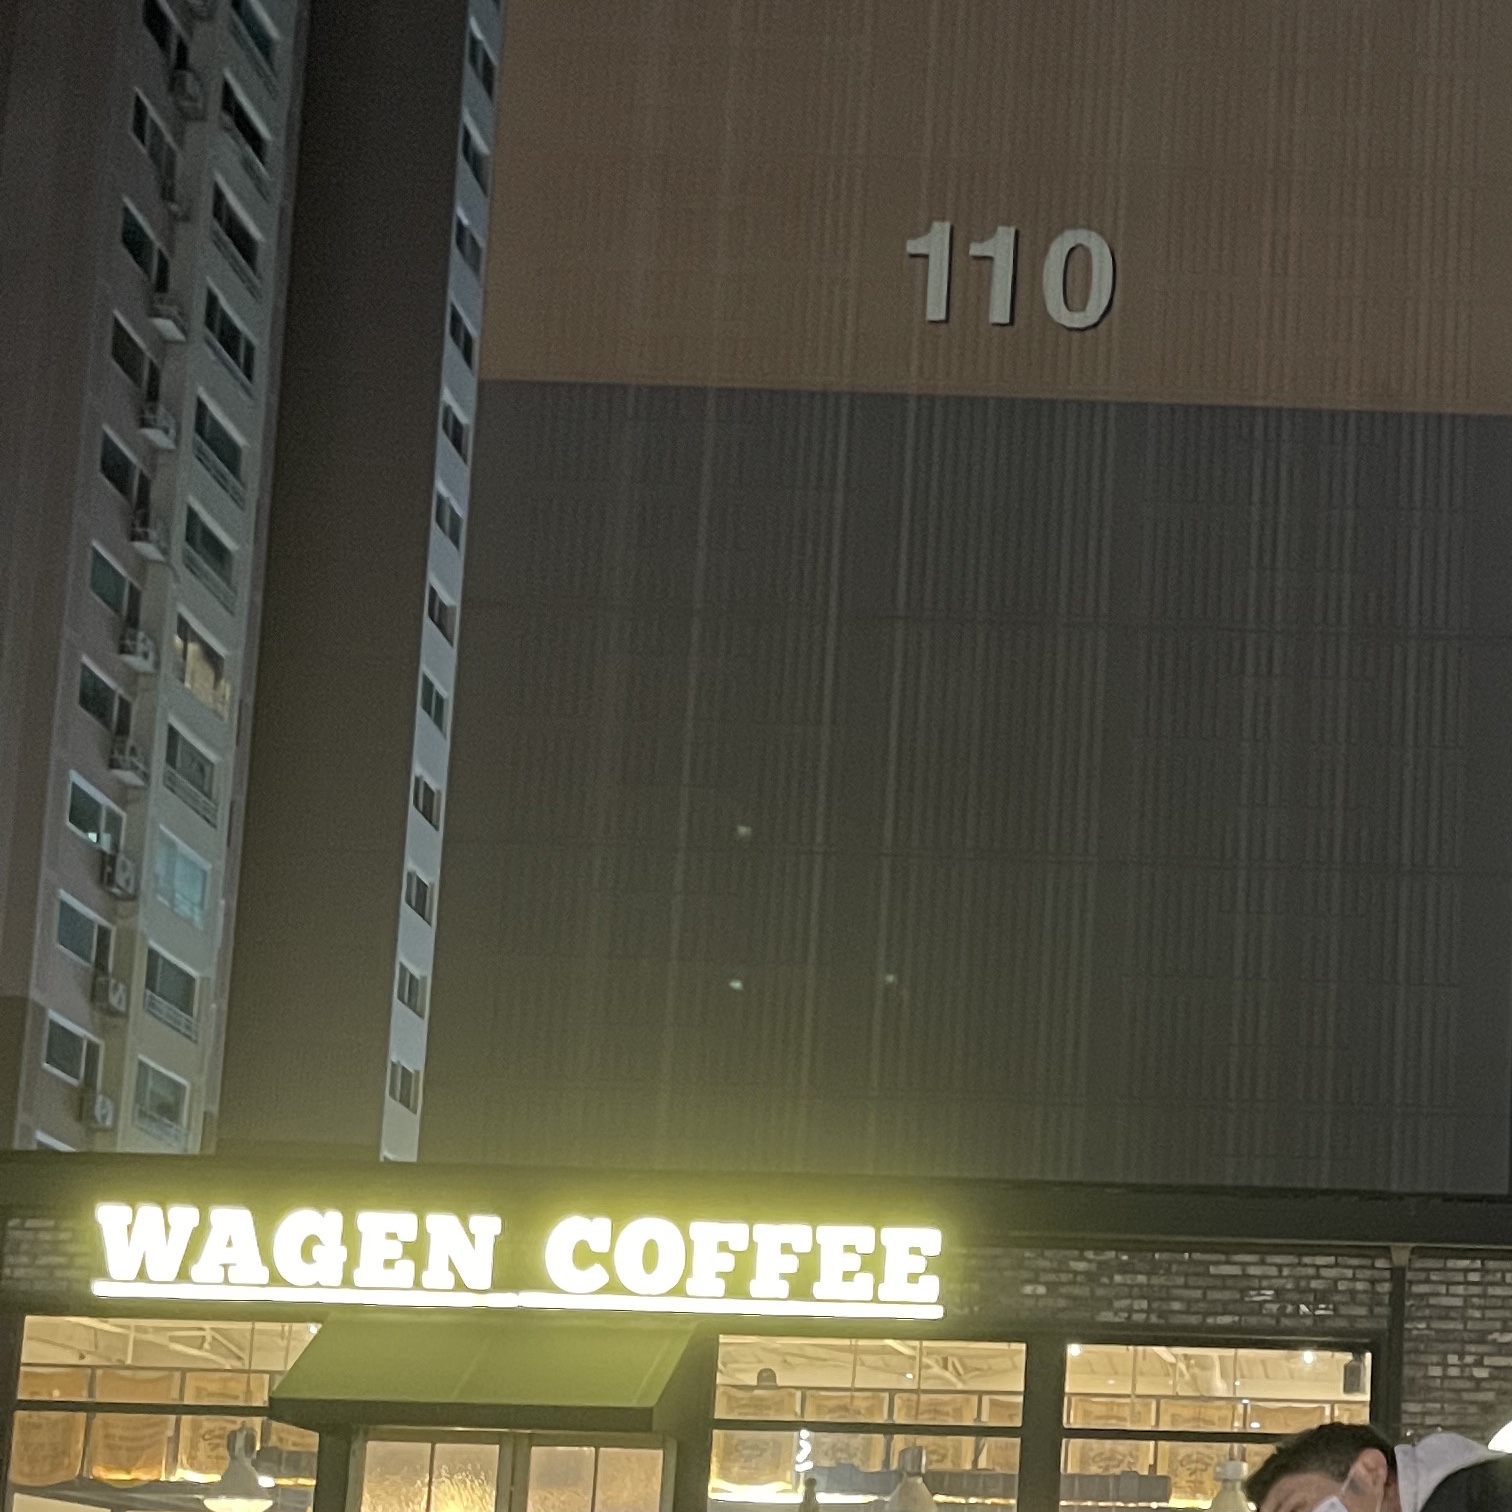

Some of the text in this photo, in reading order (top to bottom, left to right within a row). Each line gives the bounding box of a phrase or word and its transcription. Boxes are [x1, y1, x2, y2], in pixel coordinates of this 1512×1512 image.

[906, 221, 1116, 331] 110
[94, 1202, 944, 1303] WAGEN COFFEE
